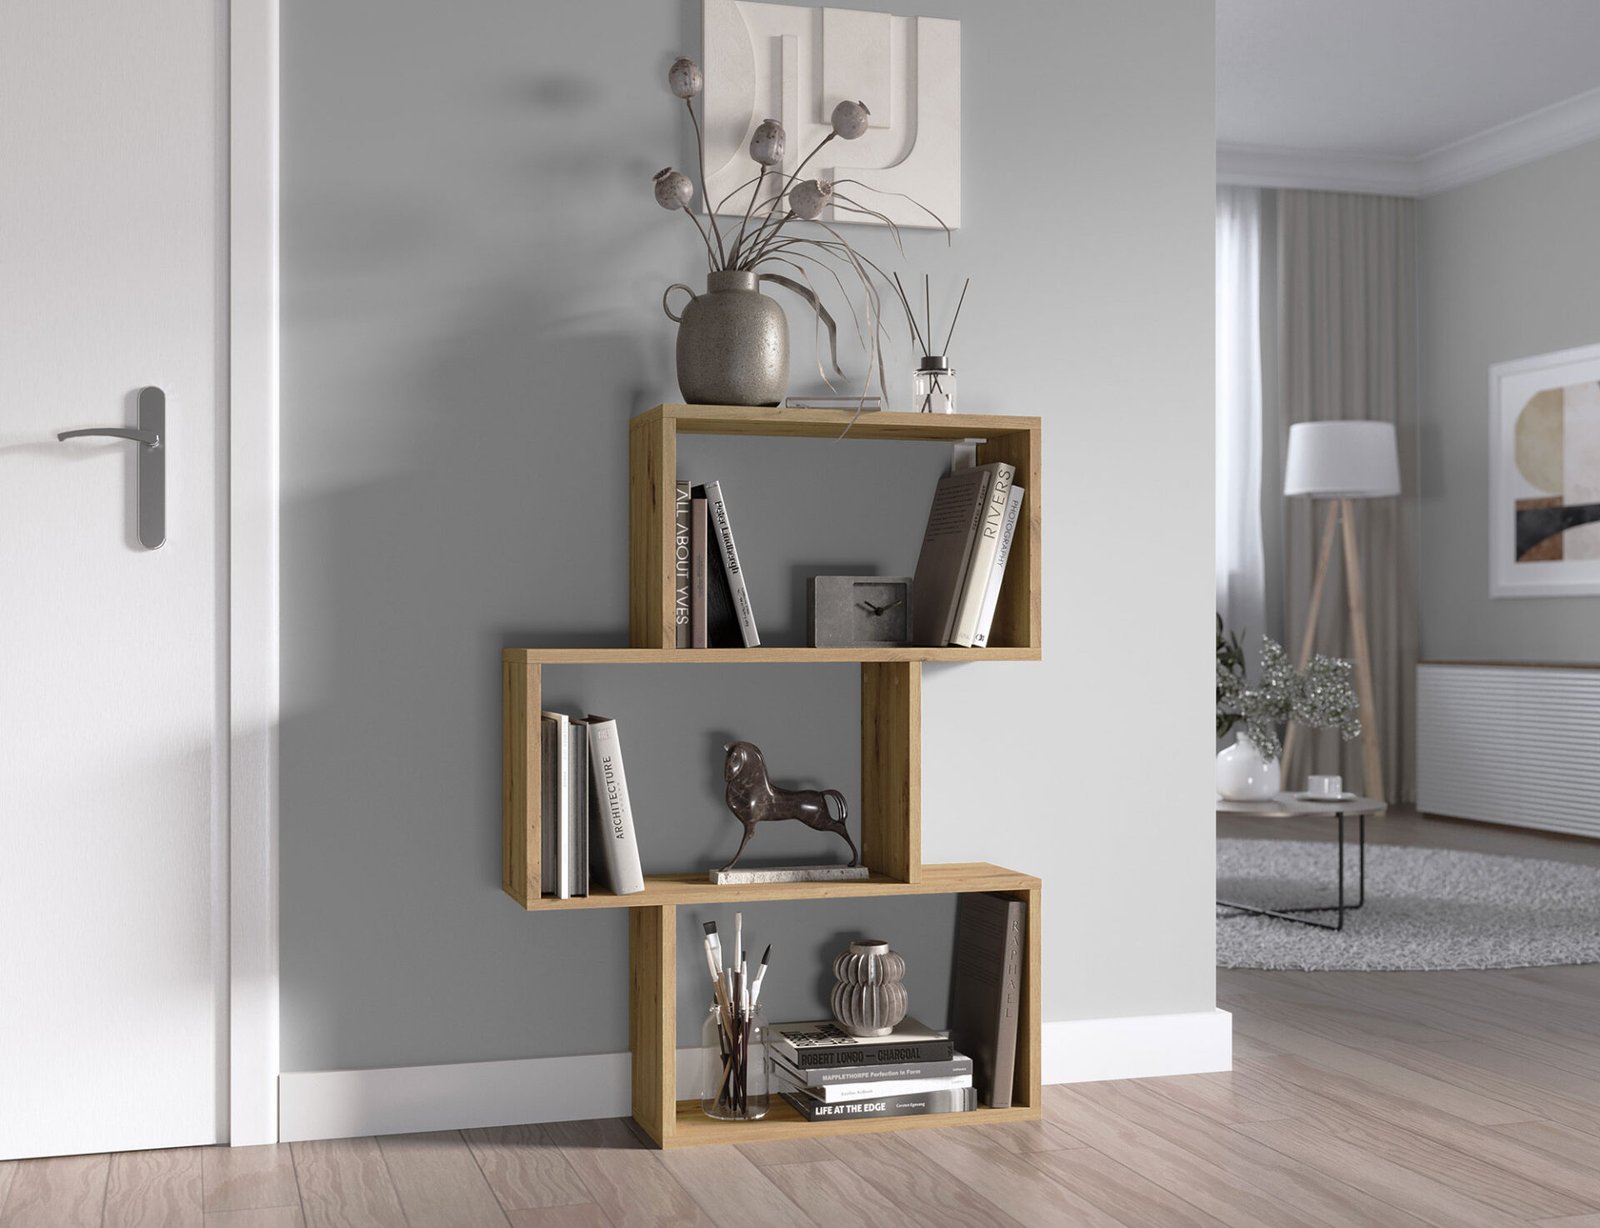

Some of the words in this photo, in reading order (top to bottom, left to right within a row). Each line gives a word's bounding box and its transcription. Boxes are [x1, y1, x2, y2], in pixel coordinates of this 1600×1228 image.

[676, 488, 688, 517] ALL
[984, 469, 1011, 540] RIVERS
[676, 523, 688, 578] ABOUT
[714, 501, 726, 526] Peter
[721, 527, 740, 574] Lindbergh
[995, 500, 1018, 567] PHOTOGRAPHY
[676, 585, 688, 624] YVES
[602, 756, 624, 840] ARCHITECTURE
[1004, 920, 1020, 1018] RAPHAEL
[801, 1054, 834, 1066] ROBERT
[836, 1052, 864, 1064] LONGO
[878, 1047, 920, 1060] CHARCOAL
[822, 1072, 869, 1081] MAPPLETHORPE
[870, 1070, 898, 1078] Perfection
[815, 1104, 832, 1116] LIFE
[834, 1104, 846, 1114] AT
[846, 1103, 862, 1113] THE
[864, 1102, 886, 1112] EDGE
